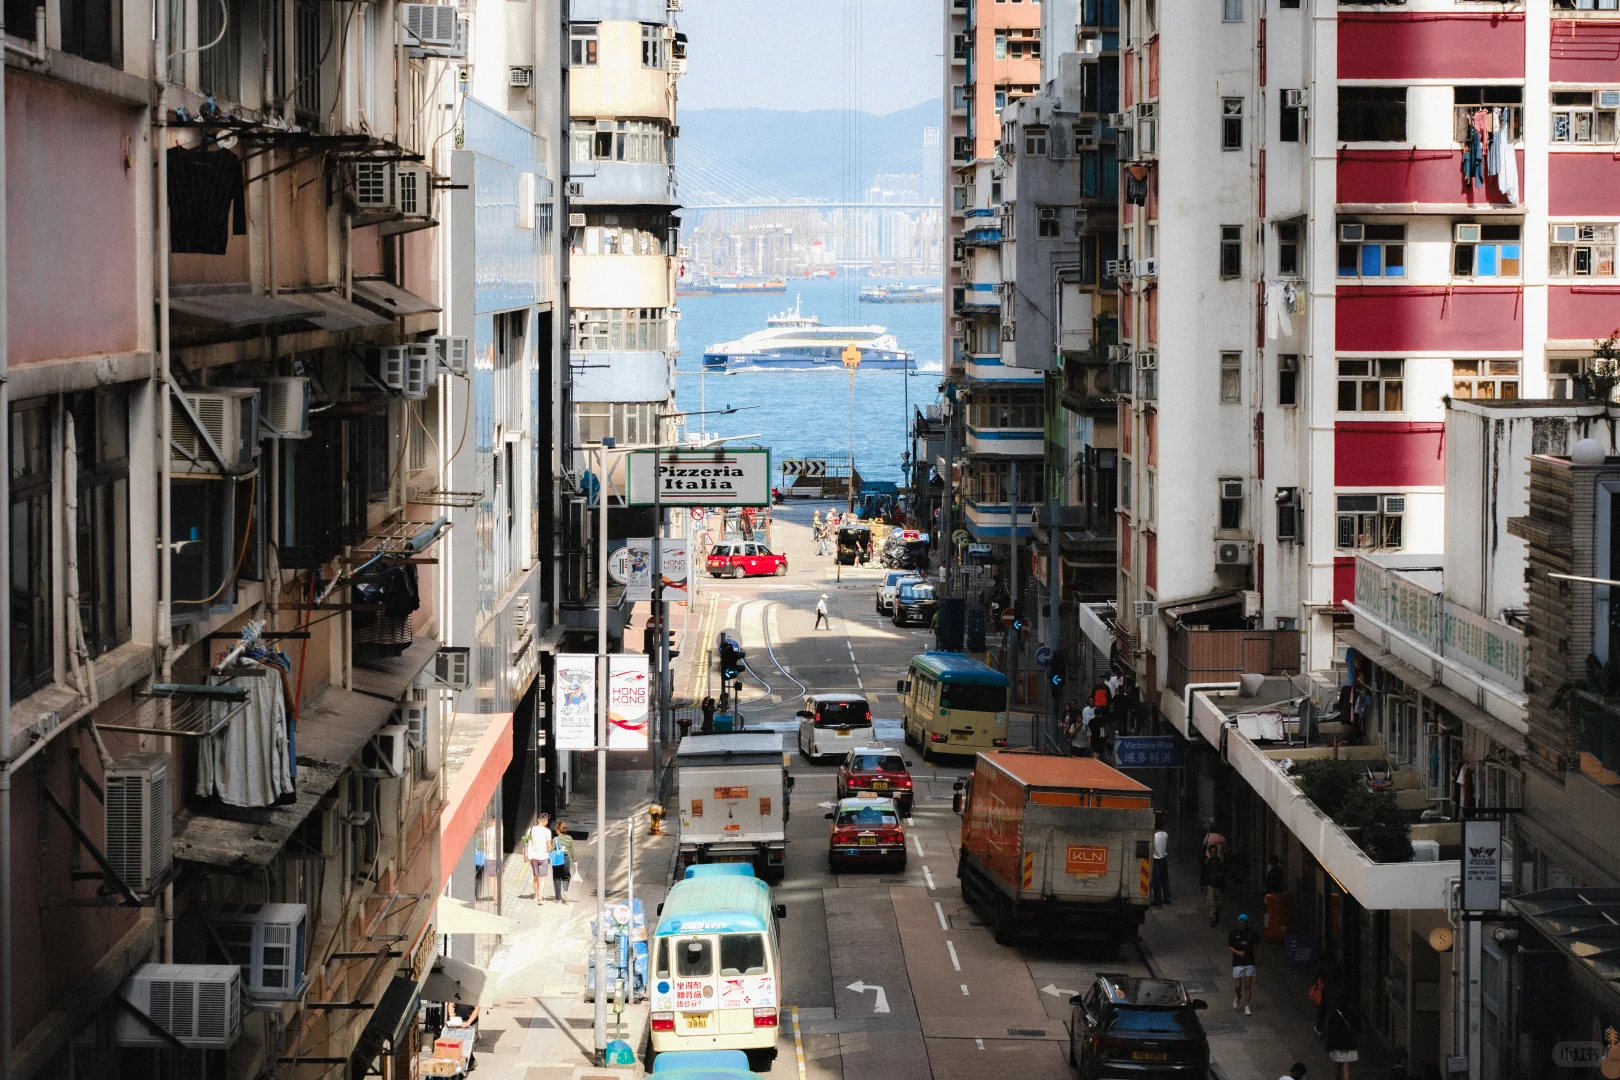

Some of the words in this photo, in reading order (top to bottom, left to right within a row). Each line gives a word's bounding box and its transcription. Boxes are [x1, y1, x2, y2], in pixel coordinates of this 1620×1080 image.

[654, 466, 744, 477] Pizzeria
[665, 478, 733, 490] Italia
[613, 687, 646, 695] HONG
[613, 696, 646, 704] KONG
[1124, 741, 1156, 749] Victoria
[1157, 741, 1174, 749] Roa
[1124, 752, 1171, 763] 域多利道
[1072, 851, 1103, 861] KLN
